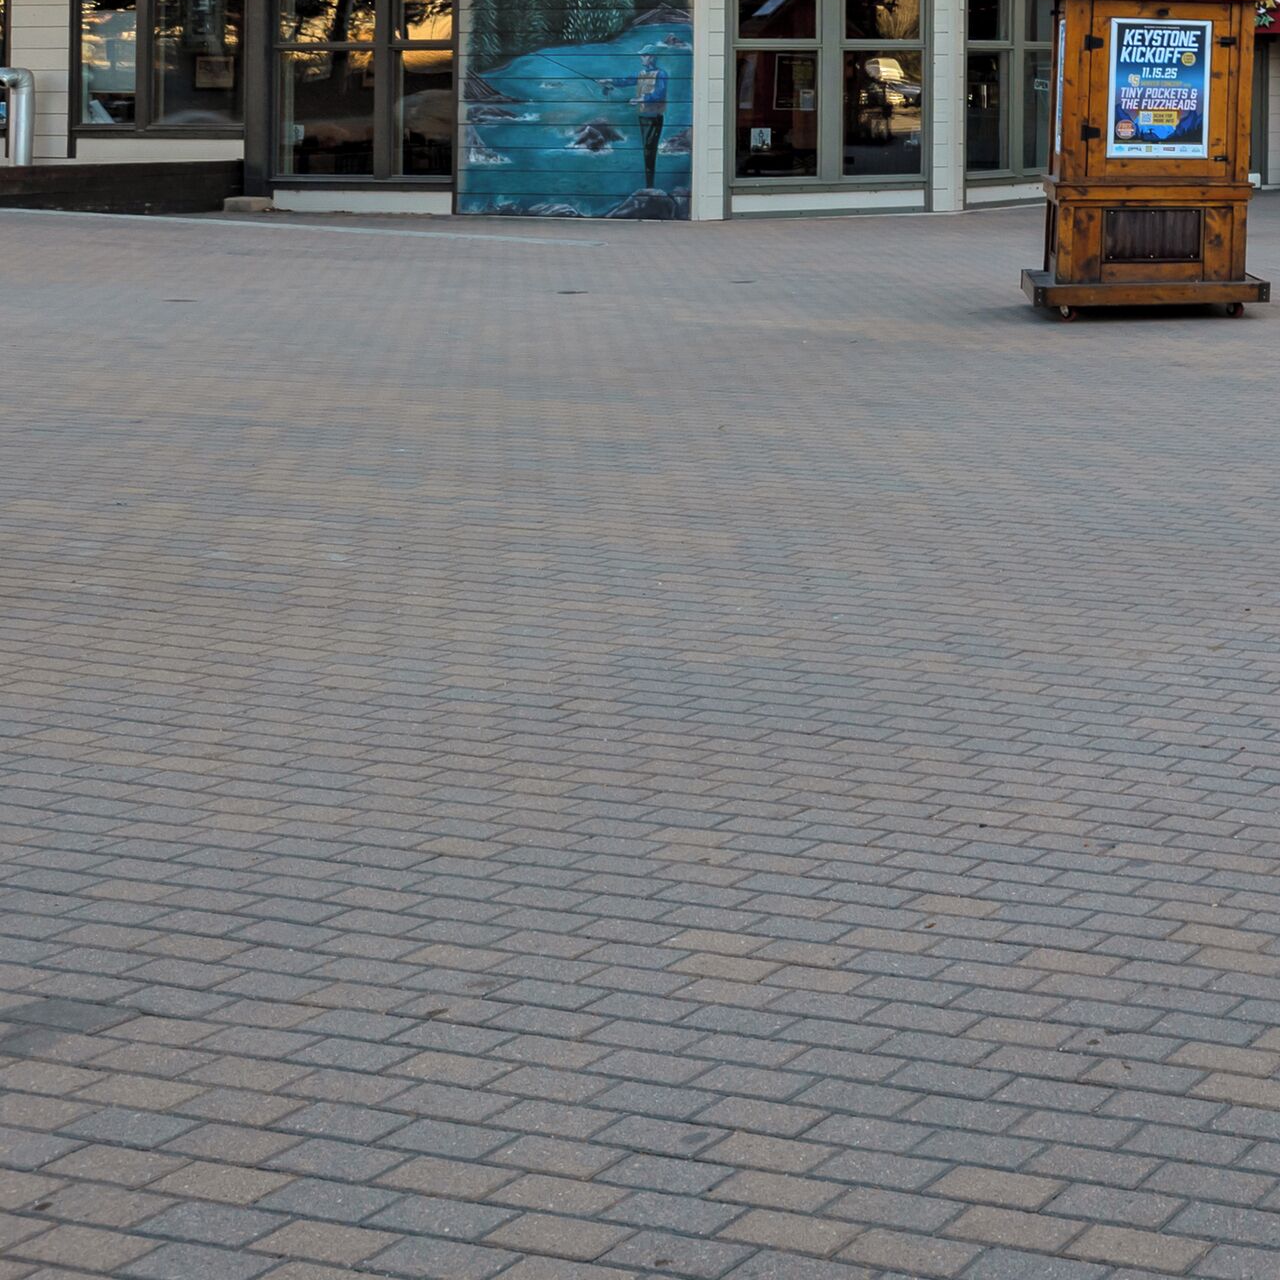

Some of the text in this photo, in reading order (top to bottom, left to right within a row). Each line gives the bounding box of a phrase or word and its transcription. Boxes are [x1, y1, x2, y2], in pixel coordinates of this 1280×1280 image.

[1123, 29, 1201, 47] KEYSTONE
[1120, 47, 1197, 63] KICKOFF
[1142, 67, 1178, 79] 11.15.25
[1121, 87, 1198, 99] TINY POCKETS &
[1121, 99, 1197, 110] THE FUZZHEADS
